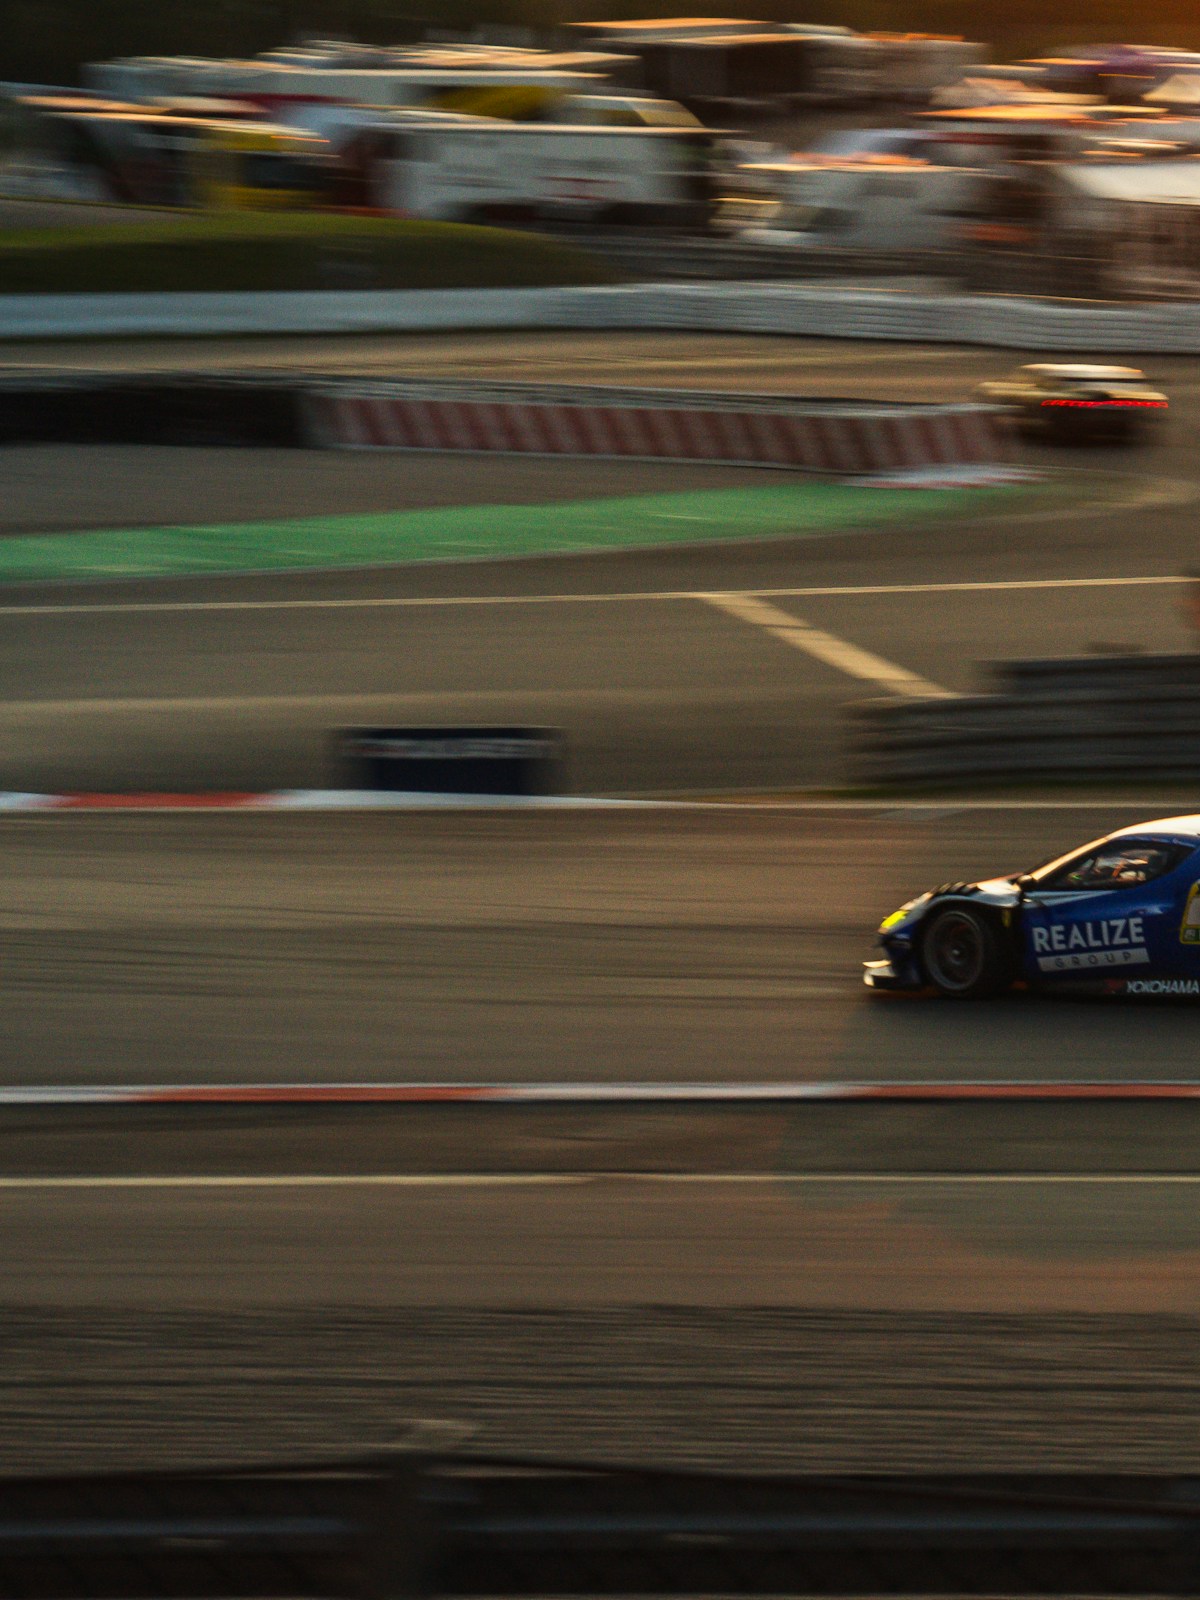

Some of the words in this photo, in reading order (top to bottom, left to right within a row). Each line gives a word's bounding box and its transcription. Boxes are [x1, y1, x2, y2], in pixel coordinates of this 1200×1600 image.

[1032, 917, 1145, 952] REALIZE
[1055, 951, 1131, 968] GROUP
[1126, 980, 1200, 994] YOKOHAMA
